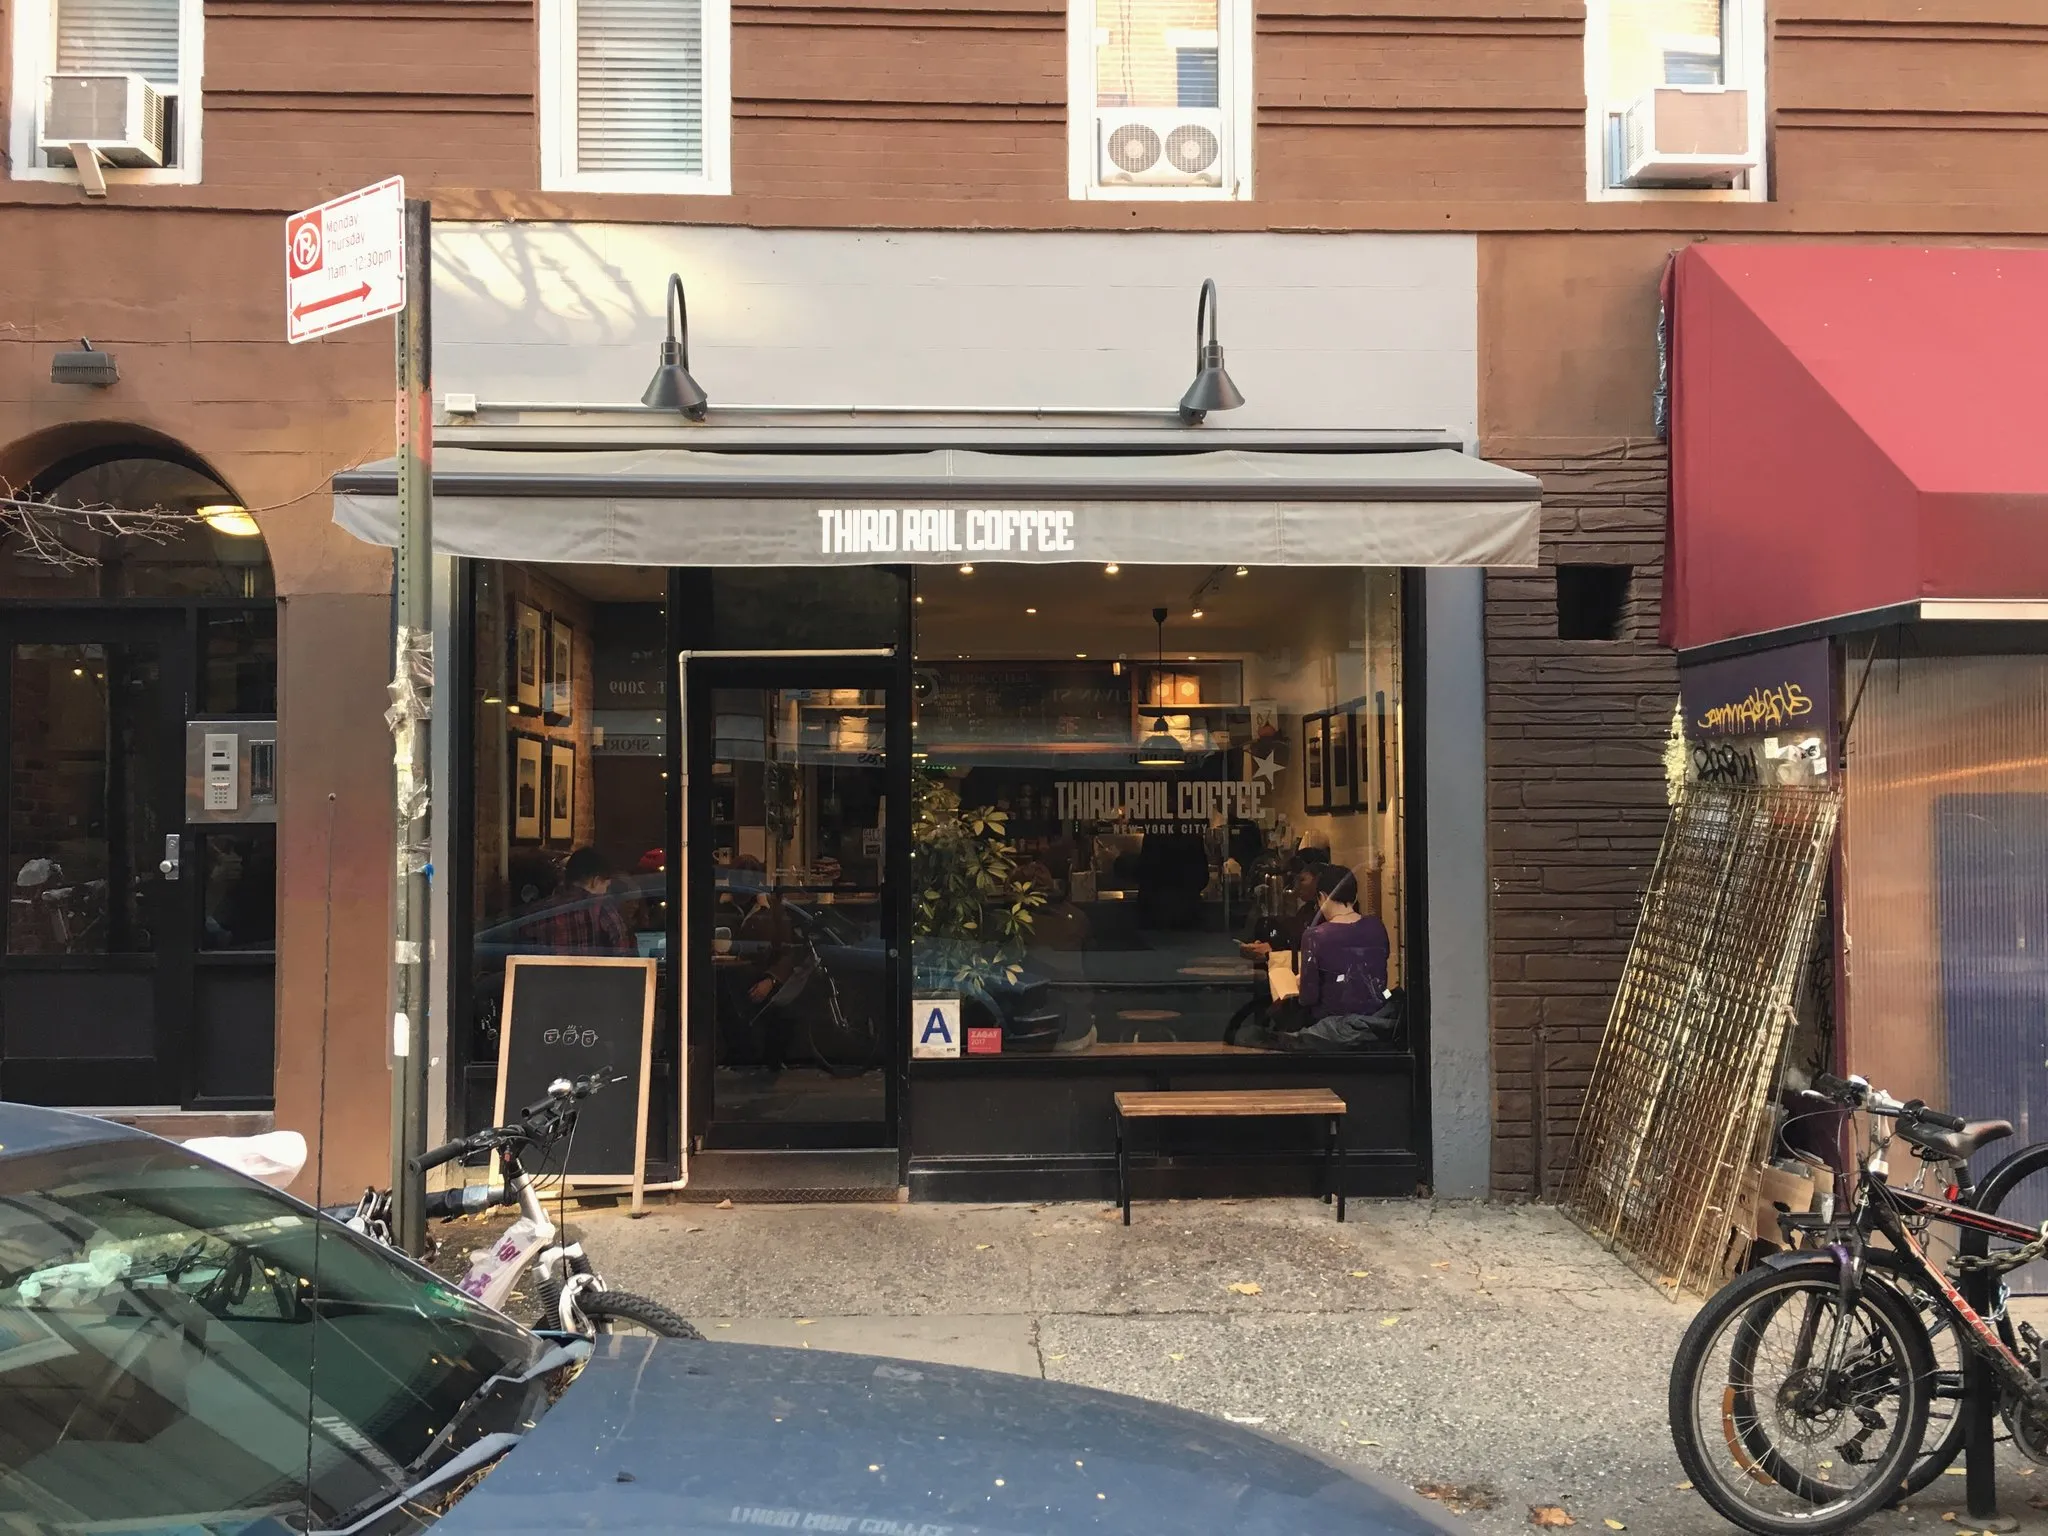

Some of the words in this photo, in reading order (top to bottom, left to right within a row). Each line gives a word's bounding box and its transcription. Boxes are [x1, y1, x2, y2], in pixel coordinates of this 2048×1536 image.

[326, 213, 359, 232] Monday
[327, 231, 366, 252] Thursday
[328, 264, 347, 280] 11am
[818, 509, 897, 553] THIRD
[903, 509, 962, 551] RAIL
[966, 510, 1074, 551] COFFEE
[1054, 781, 1119, 820] THIRD
[1125, 781, 1174, 819] RAIL
[1177, 781, 1266, 819] COFFEE
[1113, 823, 1138, 835] NEW
[1144, 823, 1174, 834] YORK
[1181, 823, 1208, 834] CITY
[920, 1008, 953, 1043] A
